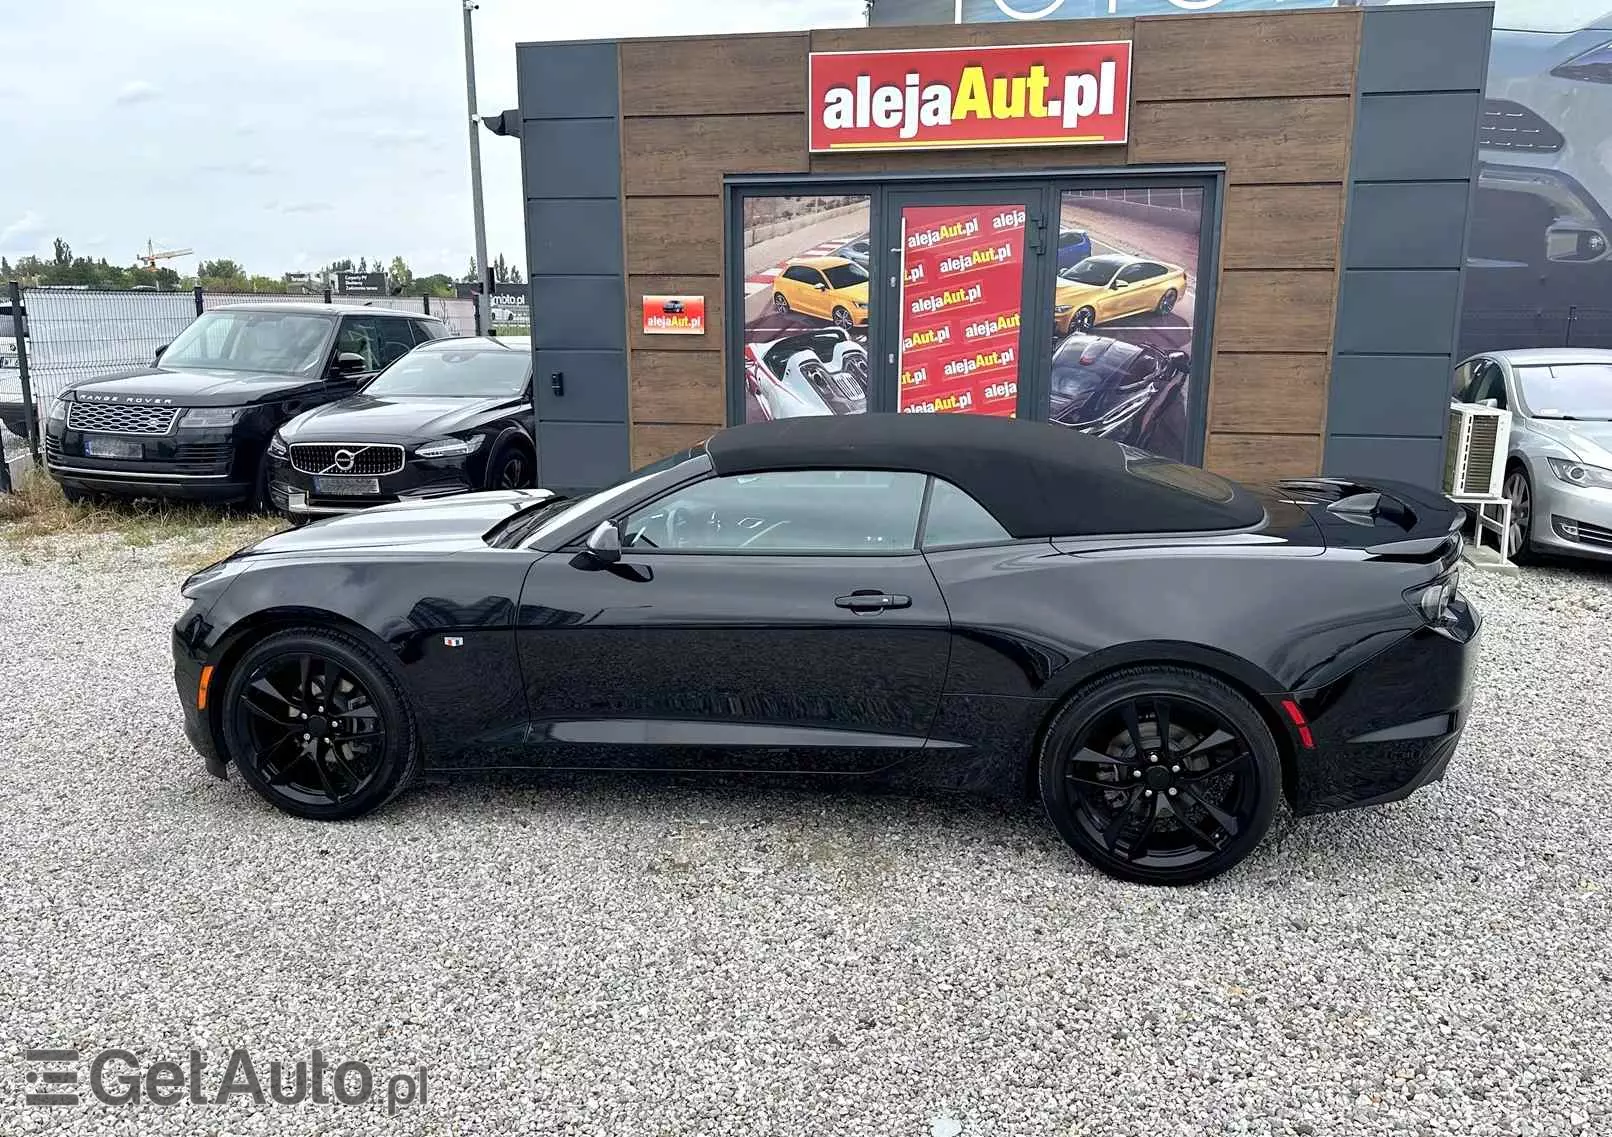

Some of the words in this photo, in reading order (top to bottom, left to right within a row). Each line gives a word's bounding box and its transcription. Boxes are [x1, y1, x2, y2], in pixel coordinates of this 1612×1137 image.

[823, 61, 1116, 138] alejaAut.pl
[908, 218, 979, 248] alejaAut.pl
[940, 243, 1012, 273] alejaAut.pl
[912, 284, 982, 313] alejaAut.pl
[648, 315, 701, 328] alejaAut.pl
[944, 348, 1014, 375] alejaAut.pl
[984, 381, 1017, 398] aleja
